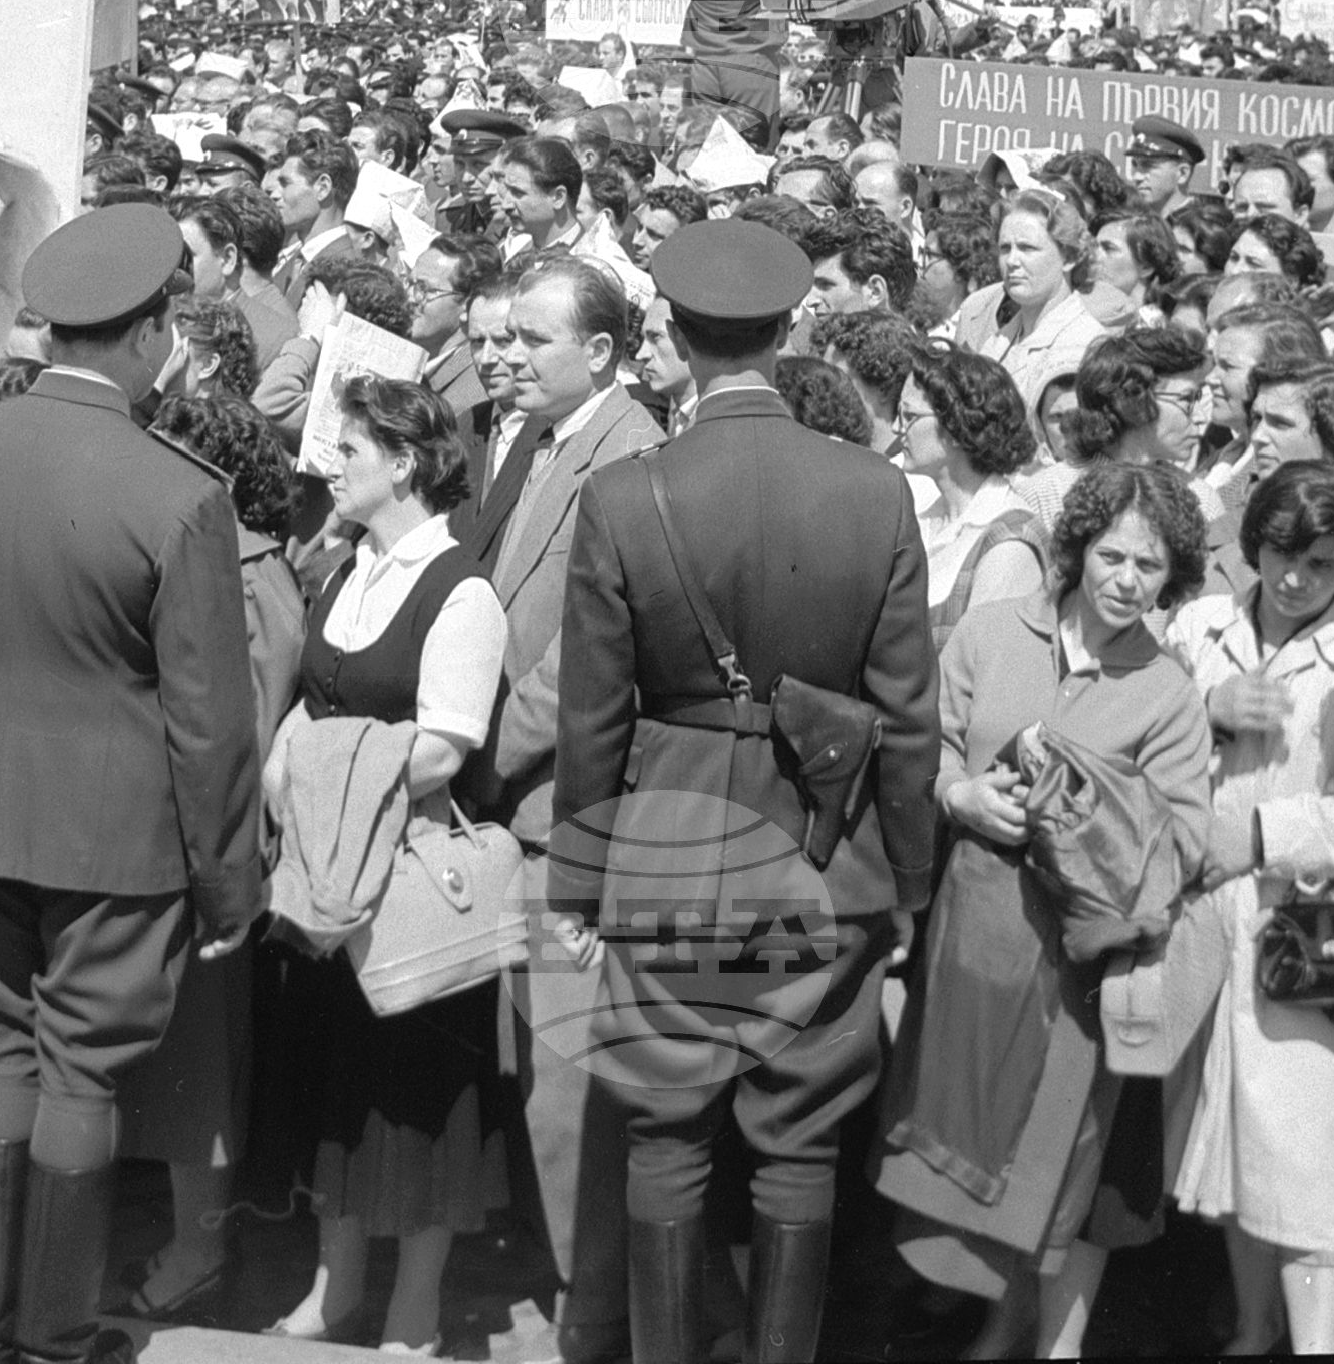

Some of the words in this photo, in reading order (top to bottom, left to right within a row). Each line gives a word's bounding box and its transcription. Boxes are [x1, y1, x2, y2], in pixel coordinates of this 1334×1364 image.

[939, 62, 1027, 114] СЛАВА
[1046, 75, 1085, 120] НА
[1102, 80, 1220, 131] ПЪРВИЯ
